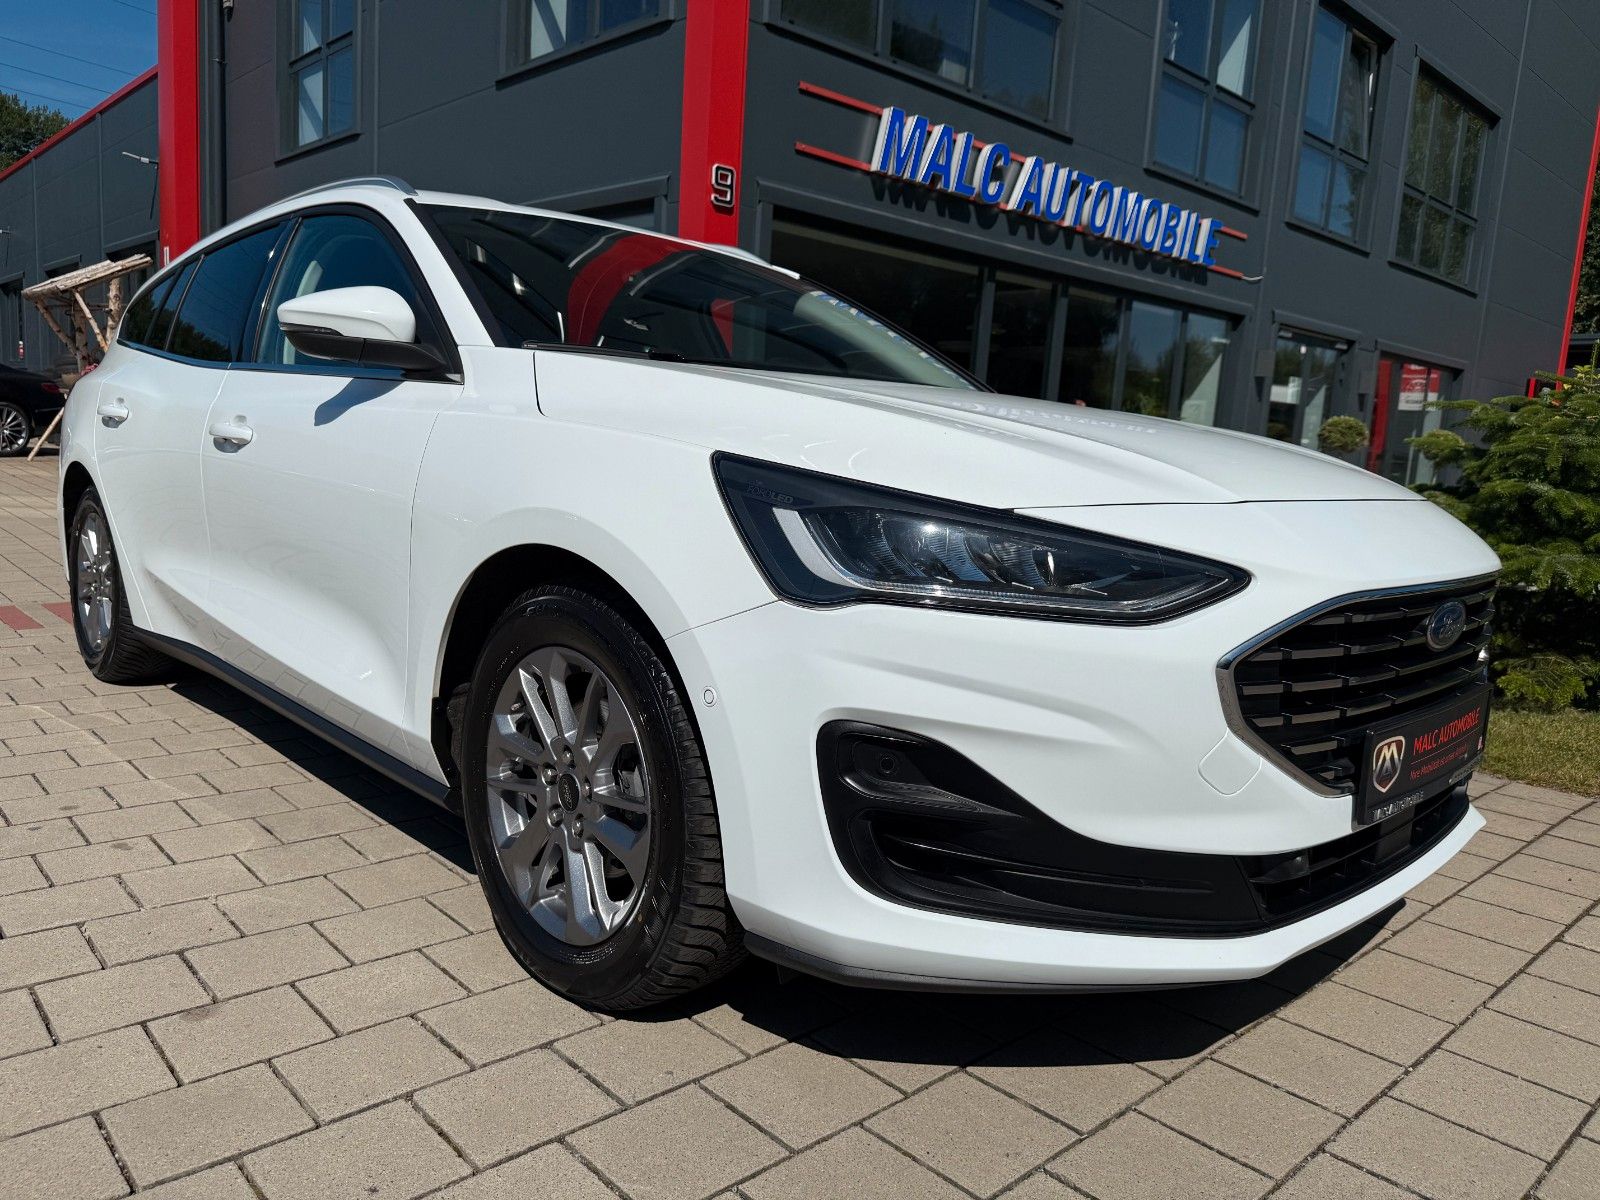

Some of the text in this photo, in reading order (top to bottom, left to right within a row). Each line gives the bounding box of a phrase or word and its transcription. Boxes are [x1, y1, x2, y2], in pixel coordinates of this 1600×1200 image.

[711, 163, 736, 207] 9
[872, 106, 1224, 267] MALC AUTOMOBILE
[1413, 729, 1439, 755] MALC
[1439, 707, 1481, 743] AUTOMOBILE
